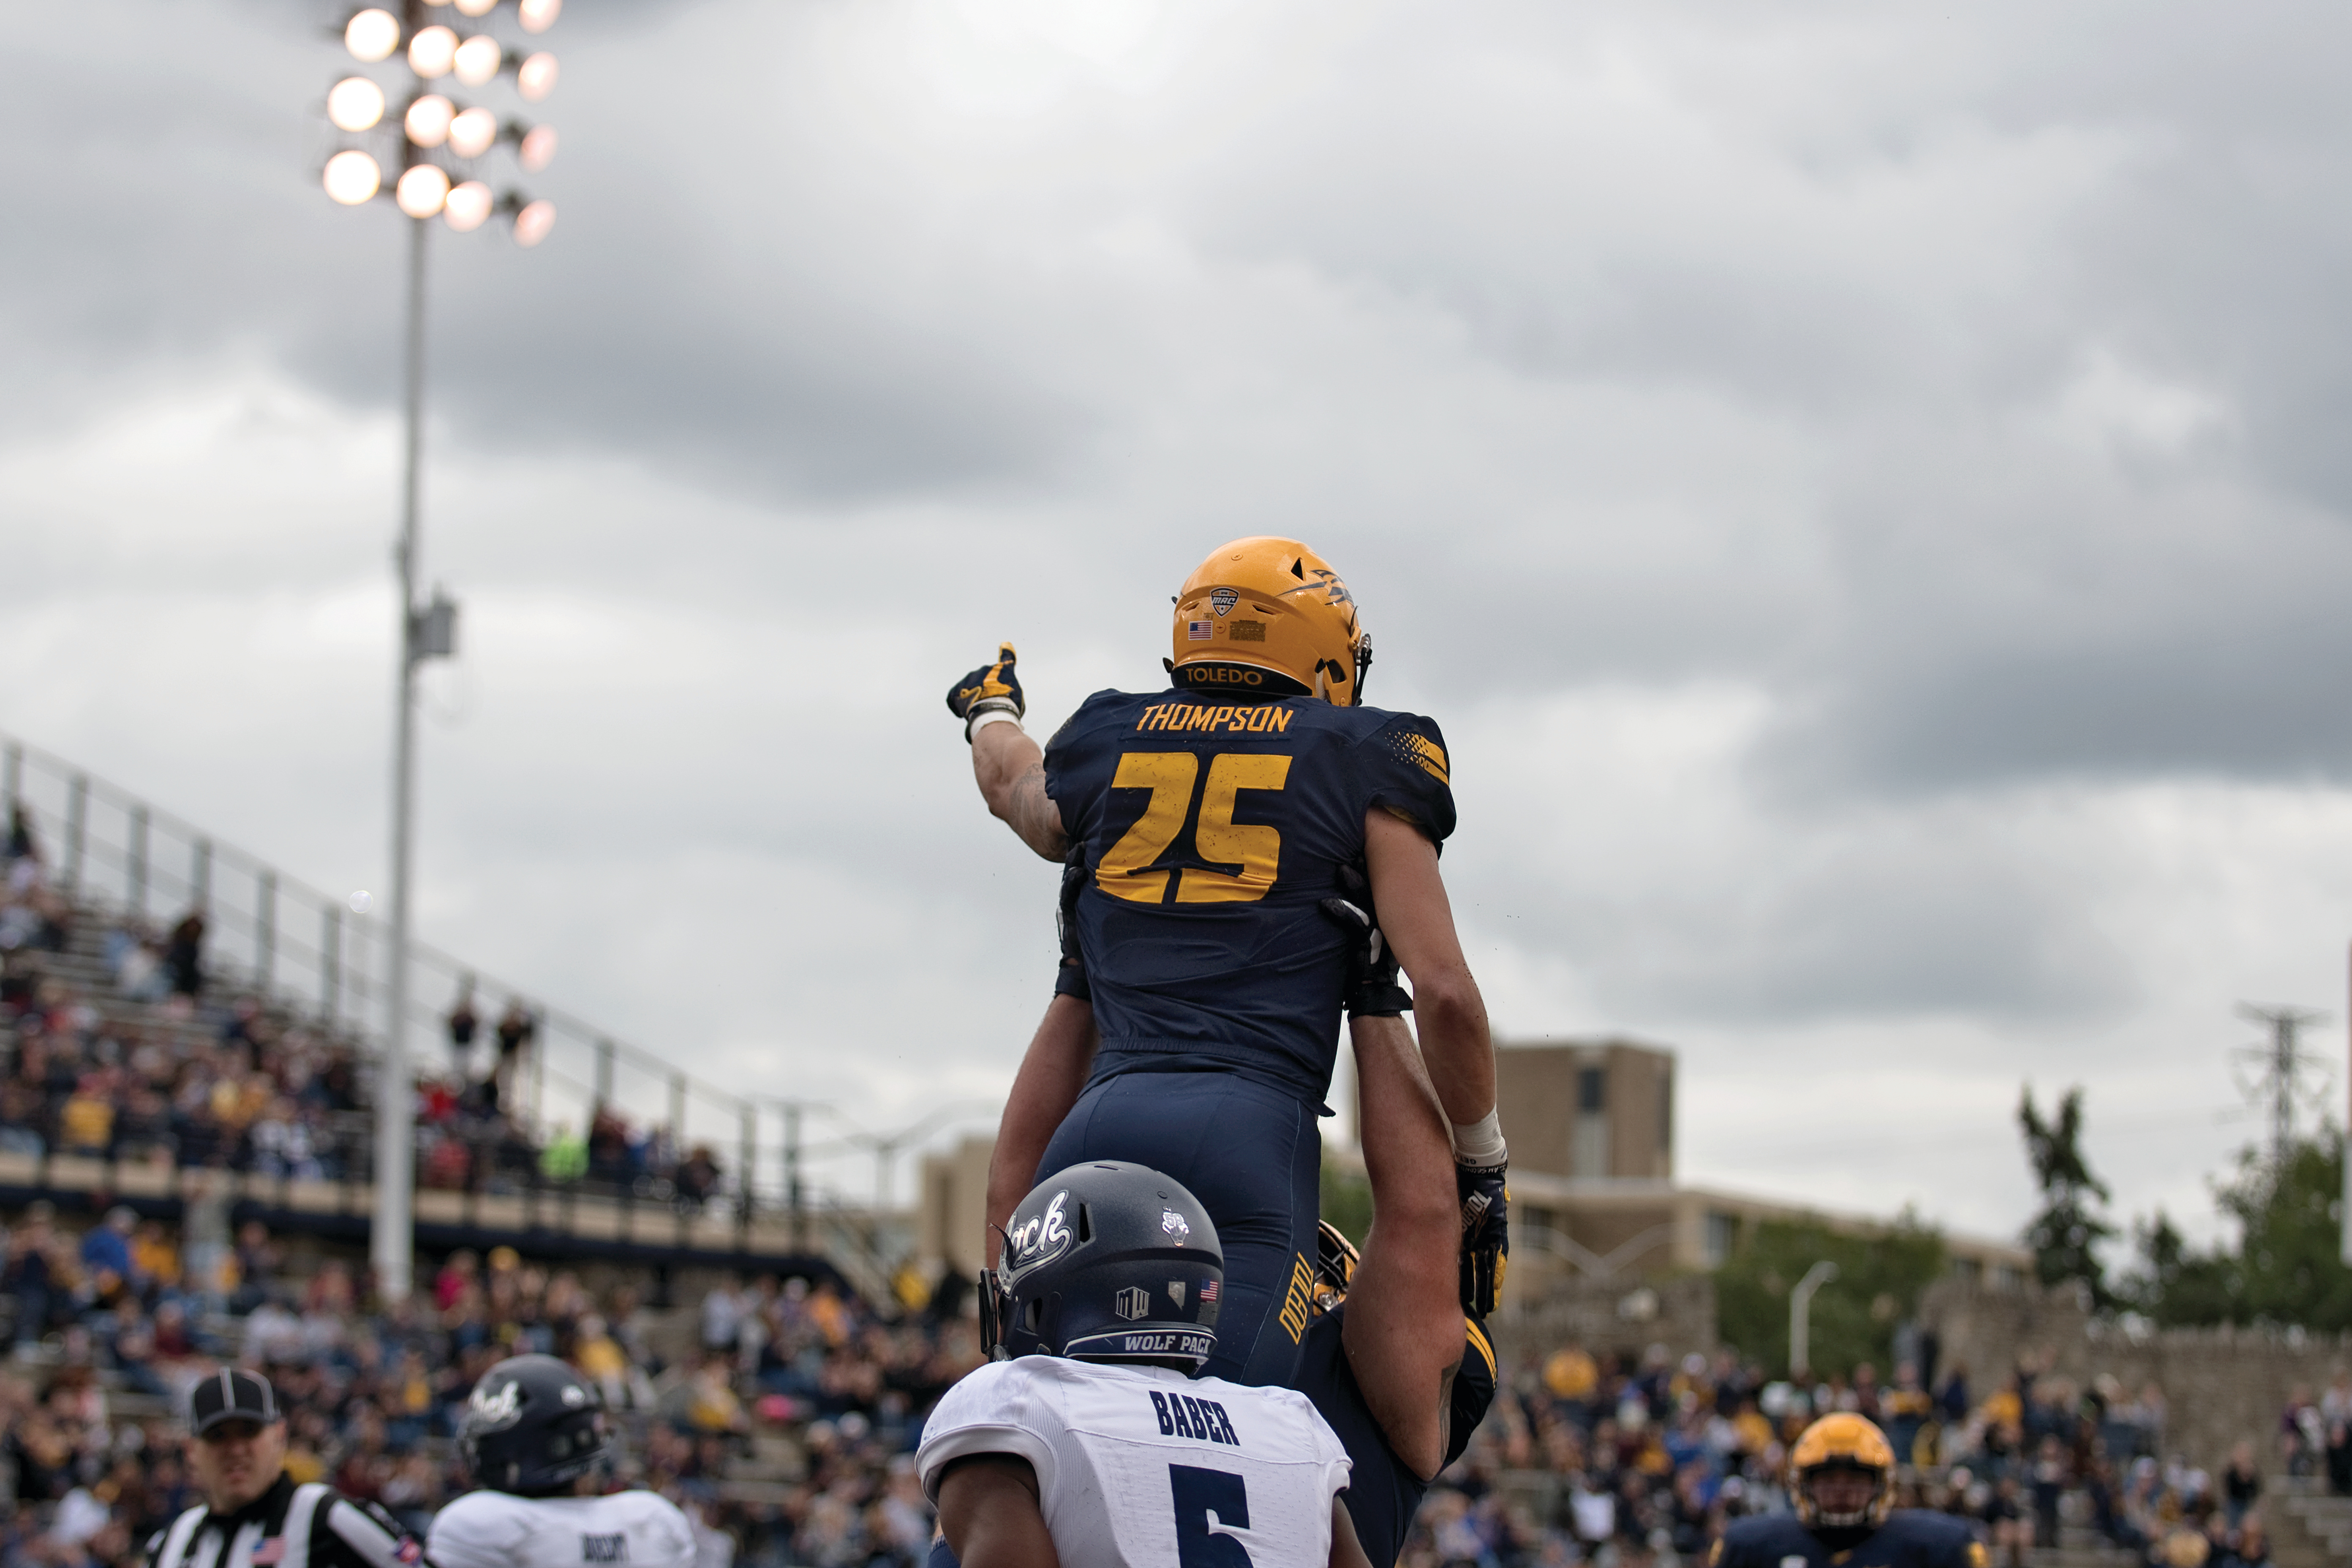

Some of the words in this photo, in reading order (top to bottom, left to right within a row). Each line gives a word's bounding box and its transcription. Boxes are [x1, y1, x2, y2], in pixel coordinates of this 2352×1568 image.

[1186, 667, 1263, 685] TOLEDO
[1136, 703, 1293, 732] THOMPSON
[1096, 752, 1293, 904] 25
[1279, 1251, 1314, 1345] TOLEDO
[1125, 1335, 1176, 1350] WOLF
[1180, 1336, 1211, 1354] PACK
[1149, 1390, 1240, 1446] BABER
